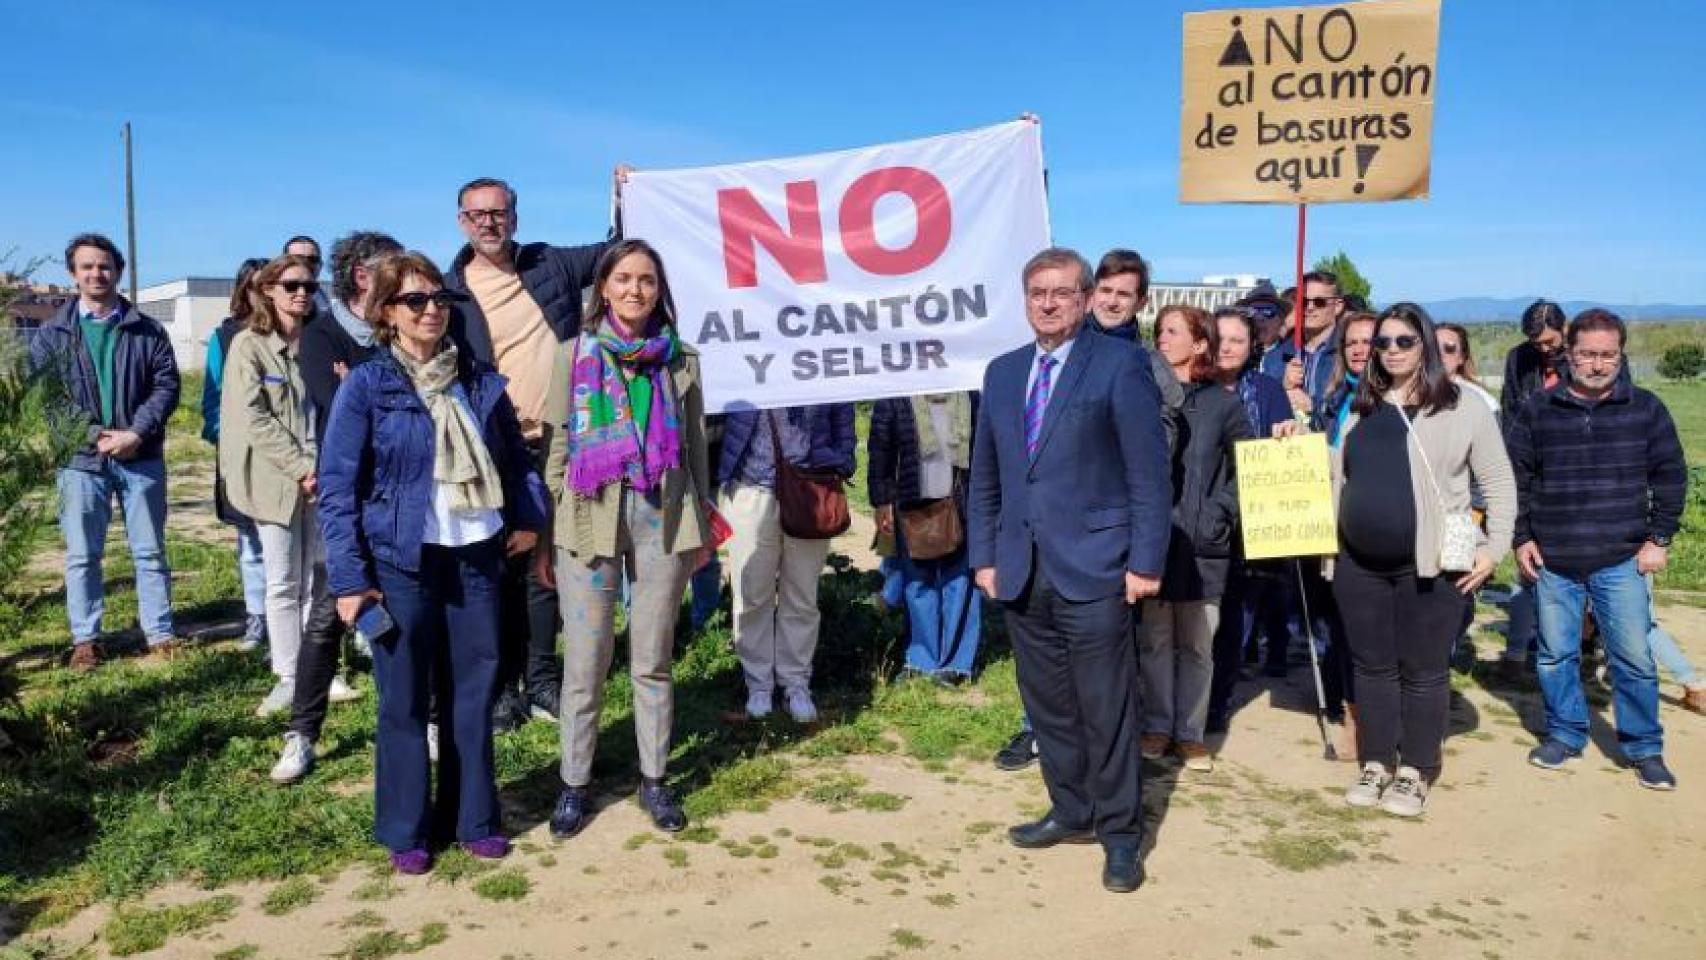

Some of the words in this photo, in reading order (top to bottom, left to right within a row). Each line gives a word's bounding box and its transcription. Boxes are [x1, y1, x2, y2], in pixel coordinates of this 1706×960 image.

[1218, 70, 1254, 107] al
[1271, 52, 1431, 101] cantón
[1195, 112, 1238, 149] de
[1257, 110, 1411, 145] basuras
[718, 166, 951, 289] NO
[699, 309, 760, 344] AL
[776, 285, 988, 338] CANTÓN
[745, 353, 775, 384] Y
[792, 340, 948, 381] SELUR
[1243, 445, 1269, 464] NO
